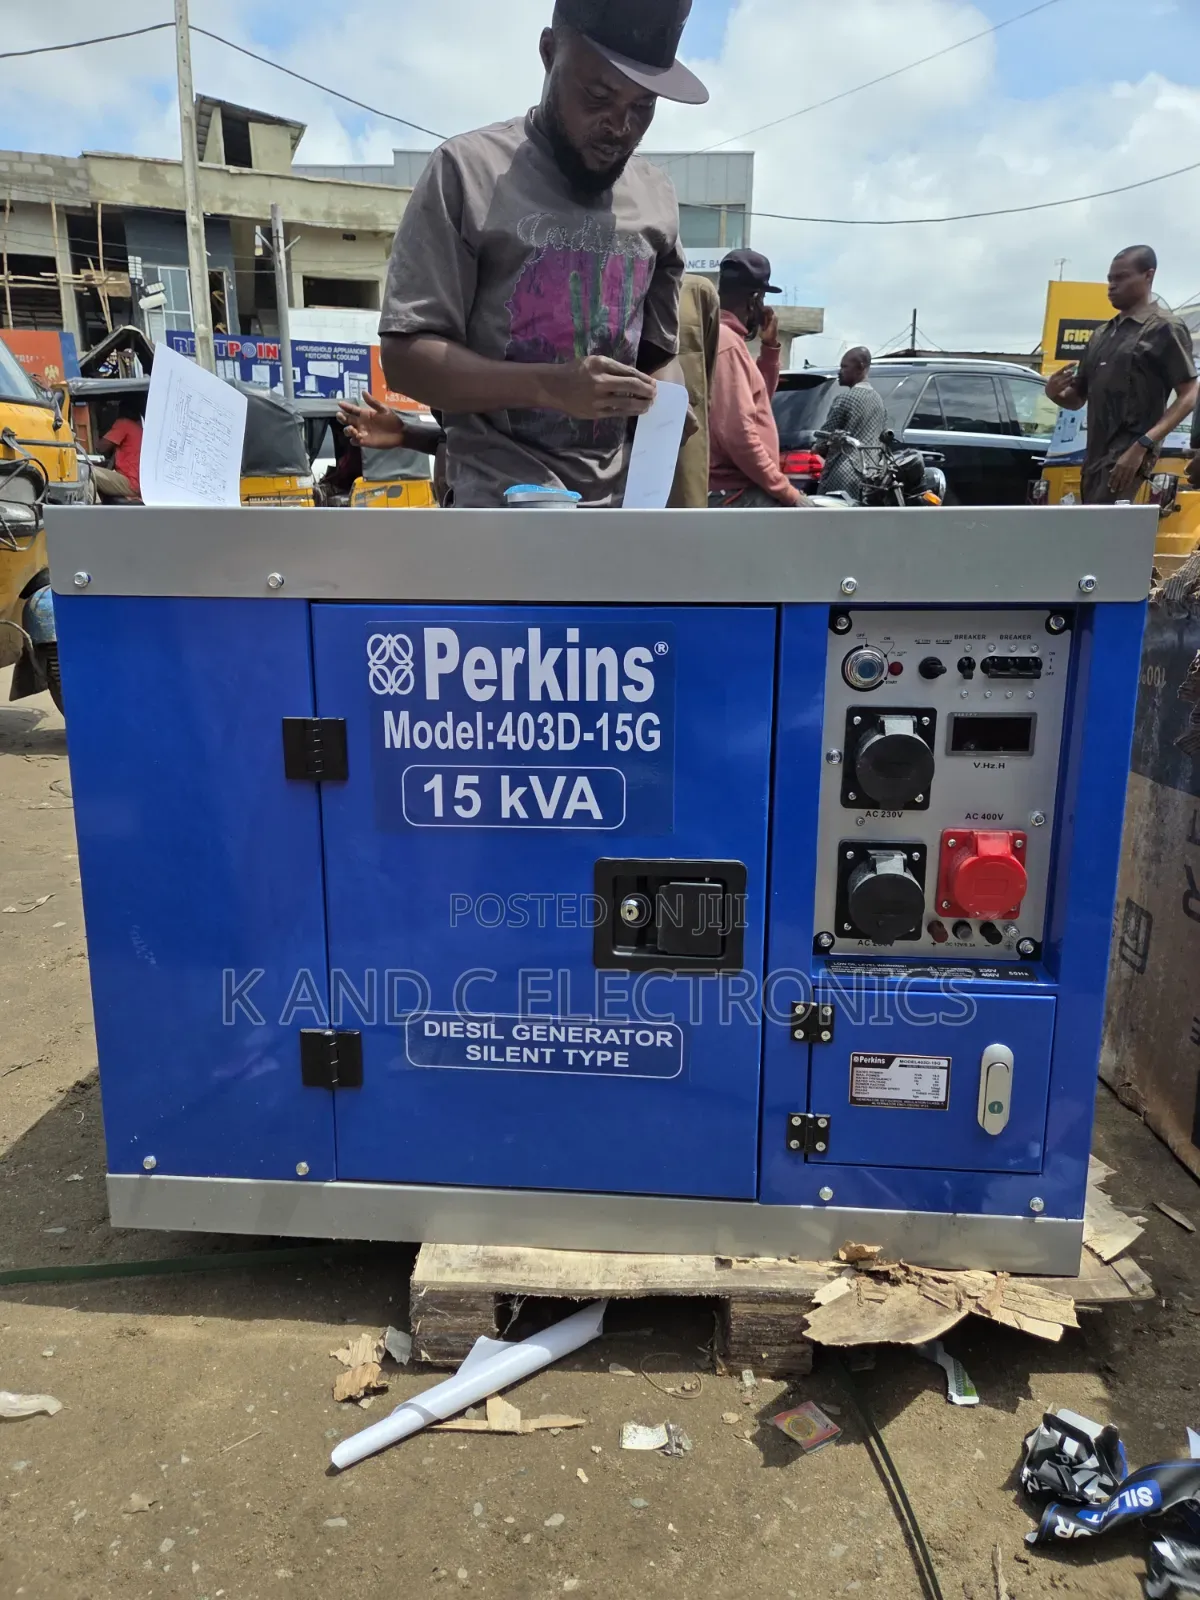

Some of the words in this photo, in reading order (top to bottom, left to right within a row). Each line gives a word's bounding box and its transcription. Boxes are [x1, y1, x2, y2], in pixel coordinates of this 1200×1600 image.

[709, 260, 721, 268] BA
[383, 710, 661, 751] Model:403D-15G
[423, 773, 482, 819] 15
[500, 775, 603, 820] kVA
[865, 810, 878, 818] AC
[965, 812, 980, 820] AC
[980, 813, 1004, 821] 400V
[424, 1020, 505, 1040] DIESIL
[511, 1025, 674, 1048] GENERATOR
[465, 1045, 556, 1064] SILENT
[562, 1048, 629, 1068] TYPE
[859, 1056, 886, 1064] Perkins
